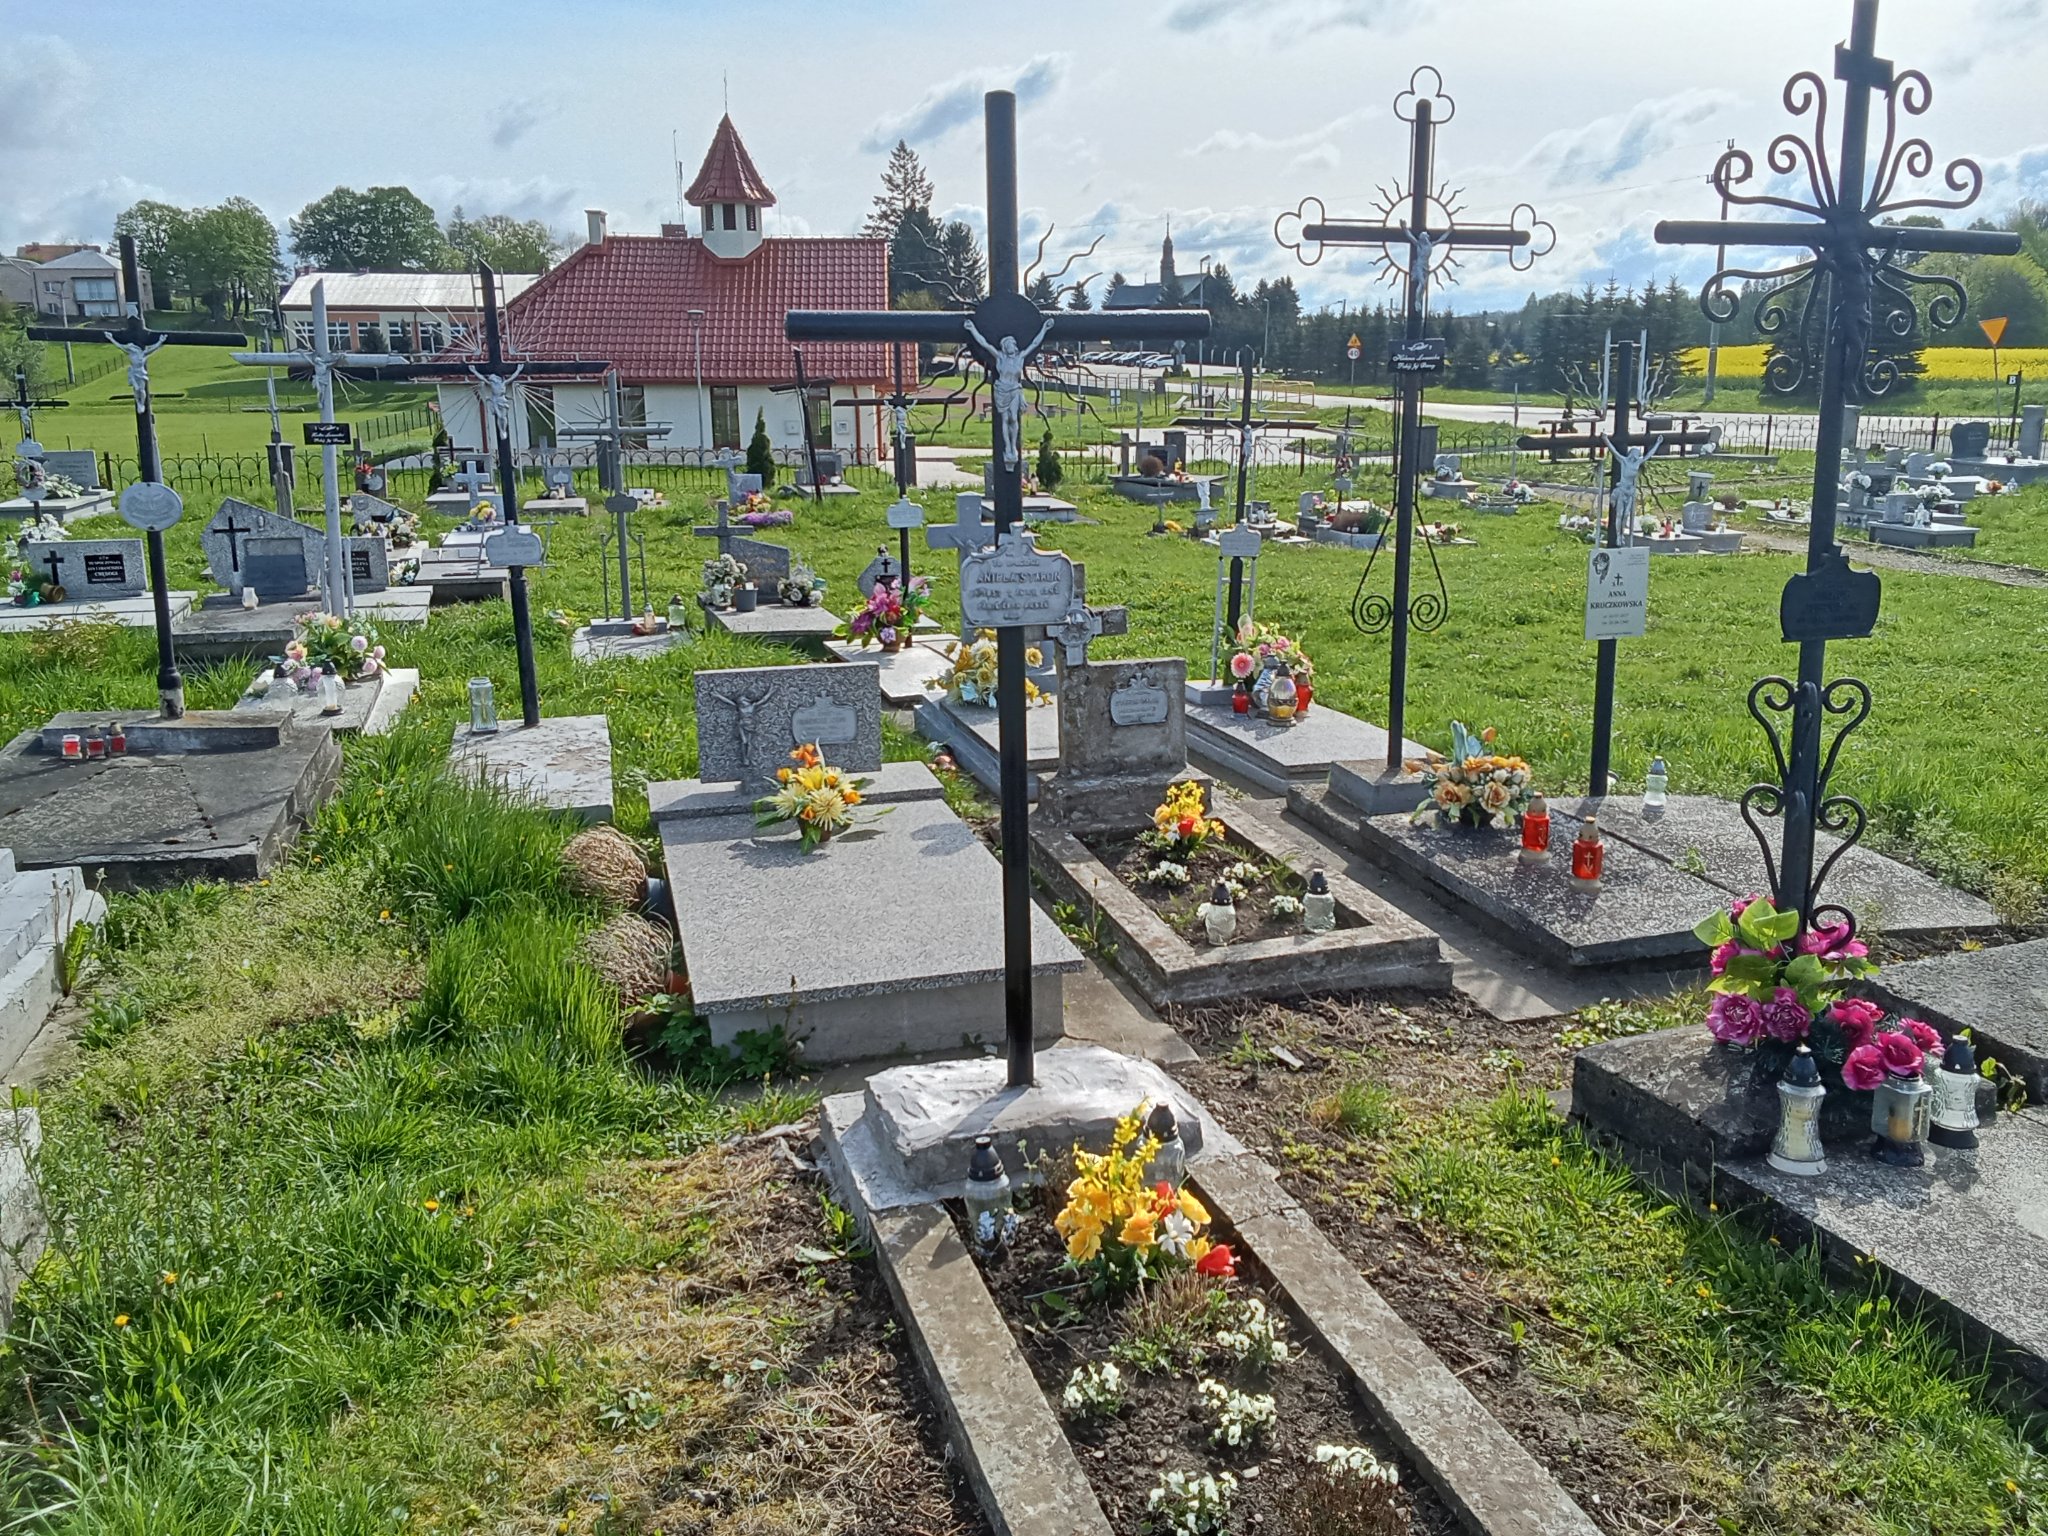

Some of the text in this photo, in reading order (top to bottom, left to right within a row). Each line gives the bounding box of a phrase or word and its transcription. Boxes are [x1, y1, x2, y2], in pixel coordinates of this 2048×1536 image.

[1350, 349, 1359, 357] 40
[1608, 590, 1627, 598] ANNA
[1590, 600, 1643, 609] KRUCZKOWSKA
